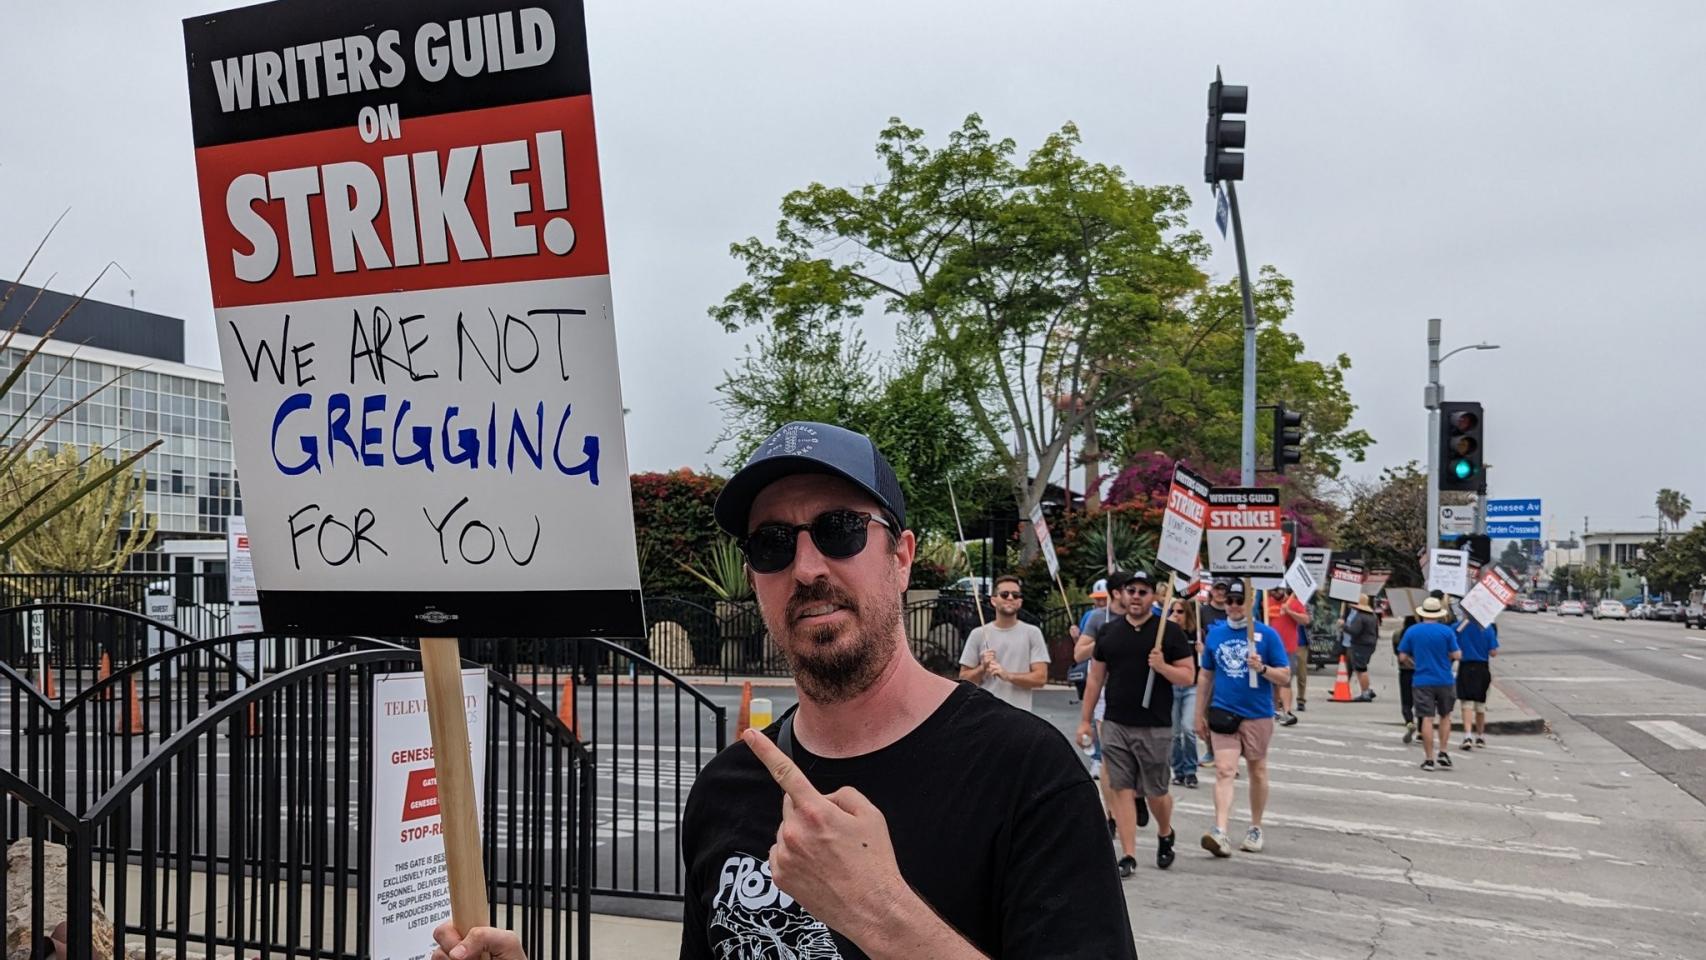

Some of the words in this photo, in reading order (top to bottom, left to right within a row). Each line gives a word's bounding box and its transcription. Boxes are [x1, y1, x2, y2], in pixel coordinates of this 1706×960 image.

[211, 29, 406, 113] WRITERS
[414, 7, 556, 82] GUILD
[358, 103, 401, 143] ON
[226, 129, 576, 282] STRIKE!
[229, 314, 316, 387] WE
[350, 306, 438, 384] ARE
[457, 307, 586, 384] NOT
[271, 393, 600, 486] GREGGING
[1209, 494, 1248, 503] WRITERS
[1249, 494, 1275, 503] GUILD
[1487, 504, 1525, 512] Genesee
[1527, 502, 1540, 511] Av
[1210, 510, 1276, 527] STRIKE!
[288, 504, 388, 570] FOR
[423, 497, 540, 566] YOU
[1226, 535, 1272, 563] 2%
[384, 699, 428, 716] TELEVI
[392, 747, 435, 764] GENESE
[410, 798, 437, 809] GENESEE
[395, 862, 408, 872] THIS
[410, 857, 425, 869] GATE
[427, 856, 433, 864] IS
[383, 870, 424, 888] EXCLUSIVELY
[425, 866, 437, 876] FOR
[417, 876, 448, 891] DELIVERIE
[387, 902, 397, 911] OR
[399, 892, 431, 908] SUPPLIERS
[382, 915, 394, 925] THE
[408, 914, 429, 930] LISTED
